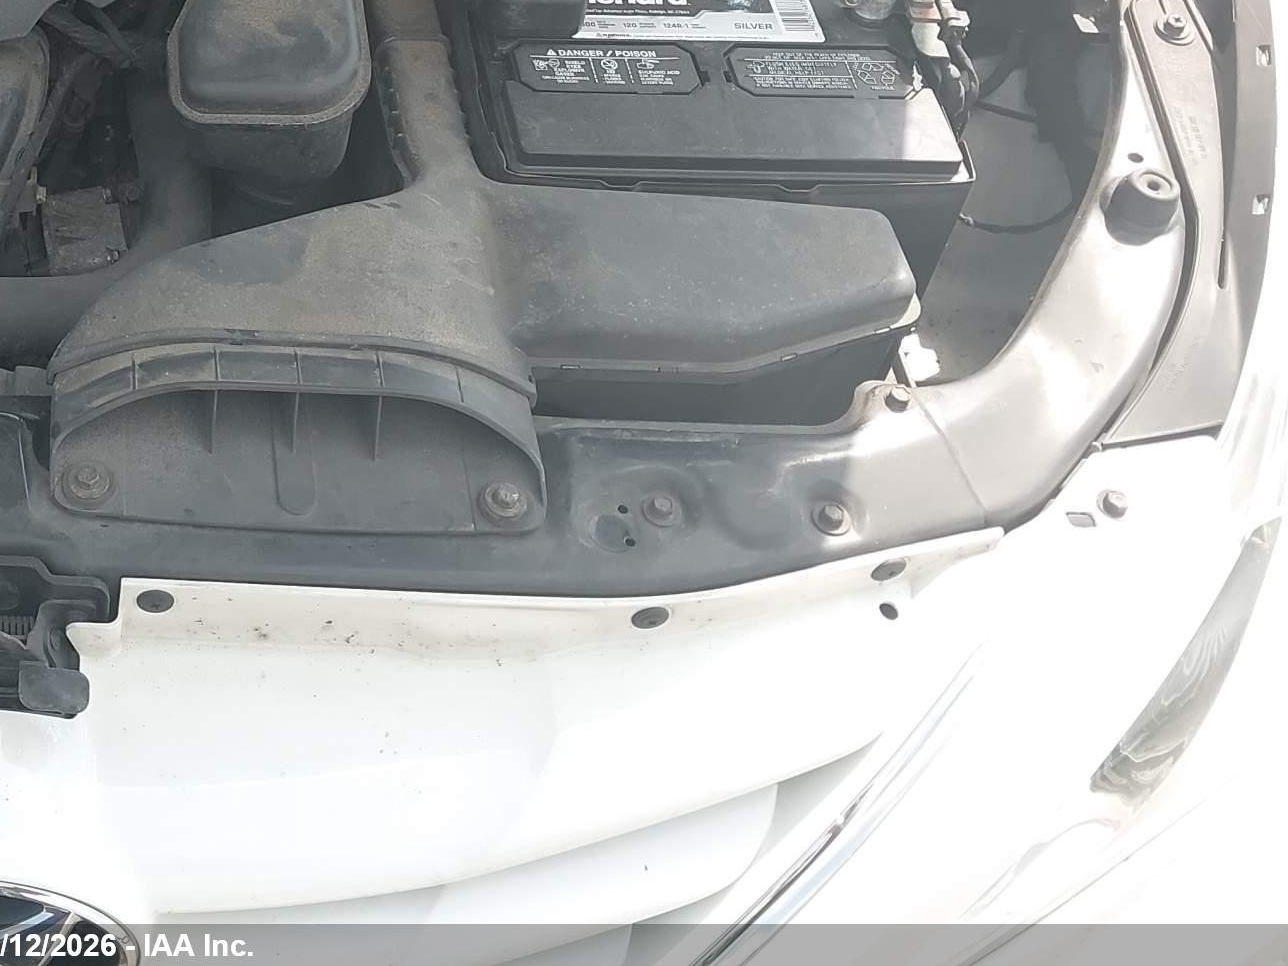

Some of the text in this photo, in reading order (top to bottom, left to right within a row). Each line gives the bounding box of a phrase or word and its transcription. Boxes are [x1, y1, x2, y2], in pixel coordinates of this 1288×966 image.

[734, 22, 773, 30] SILVER
[558, 49, 604, 57] DANGER
[615, 50, 657, 58] POISON
